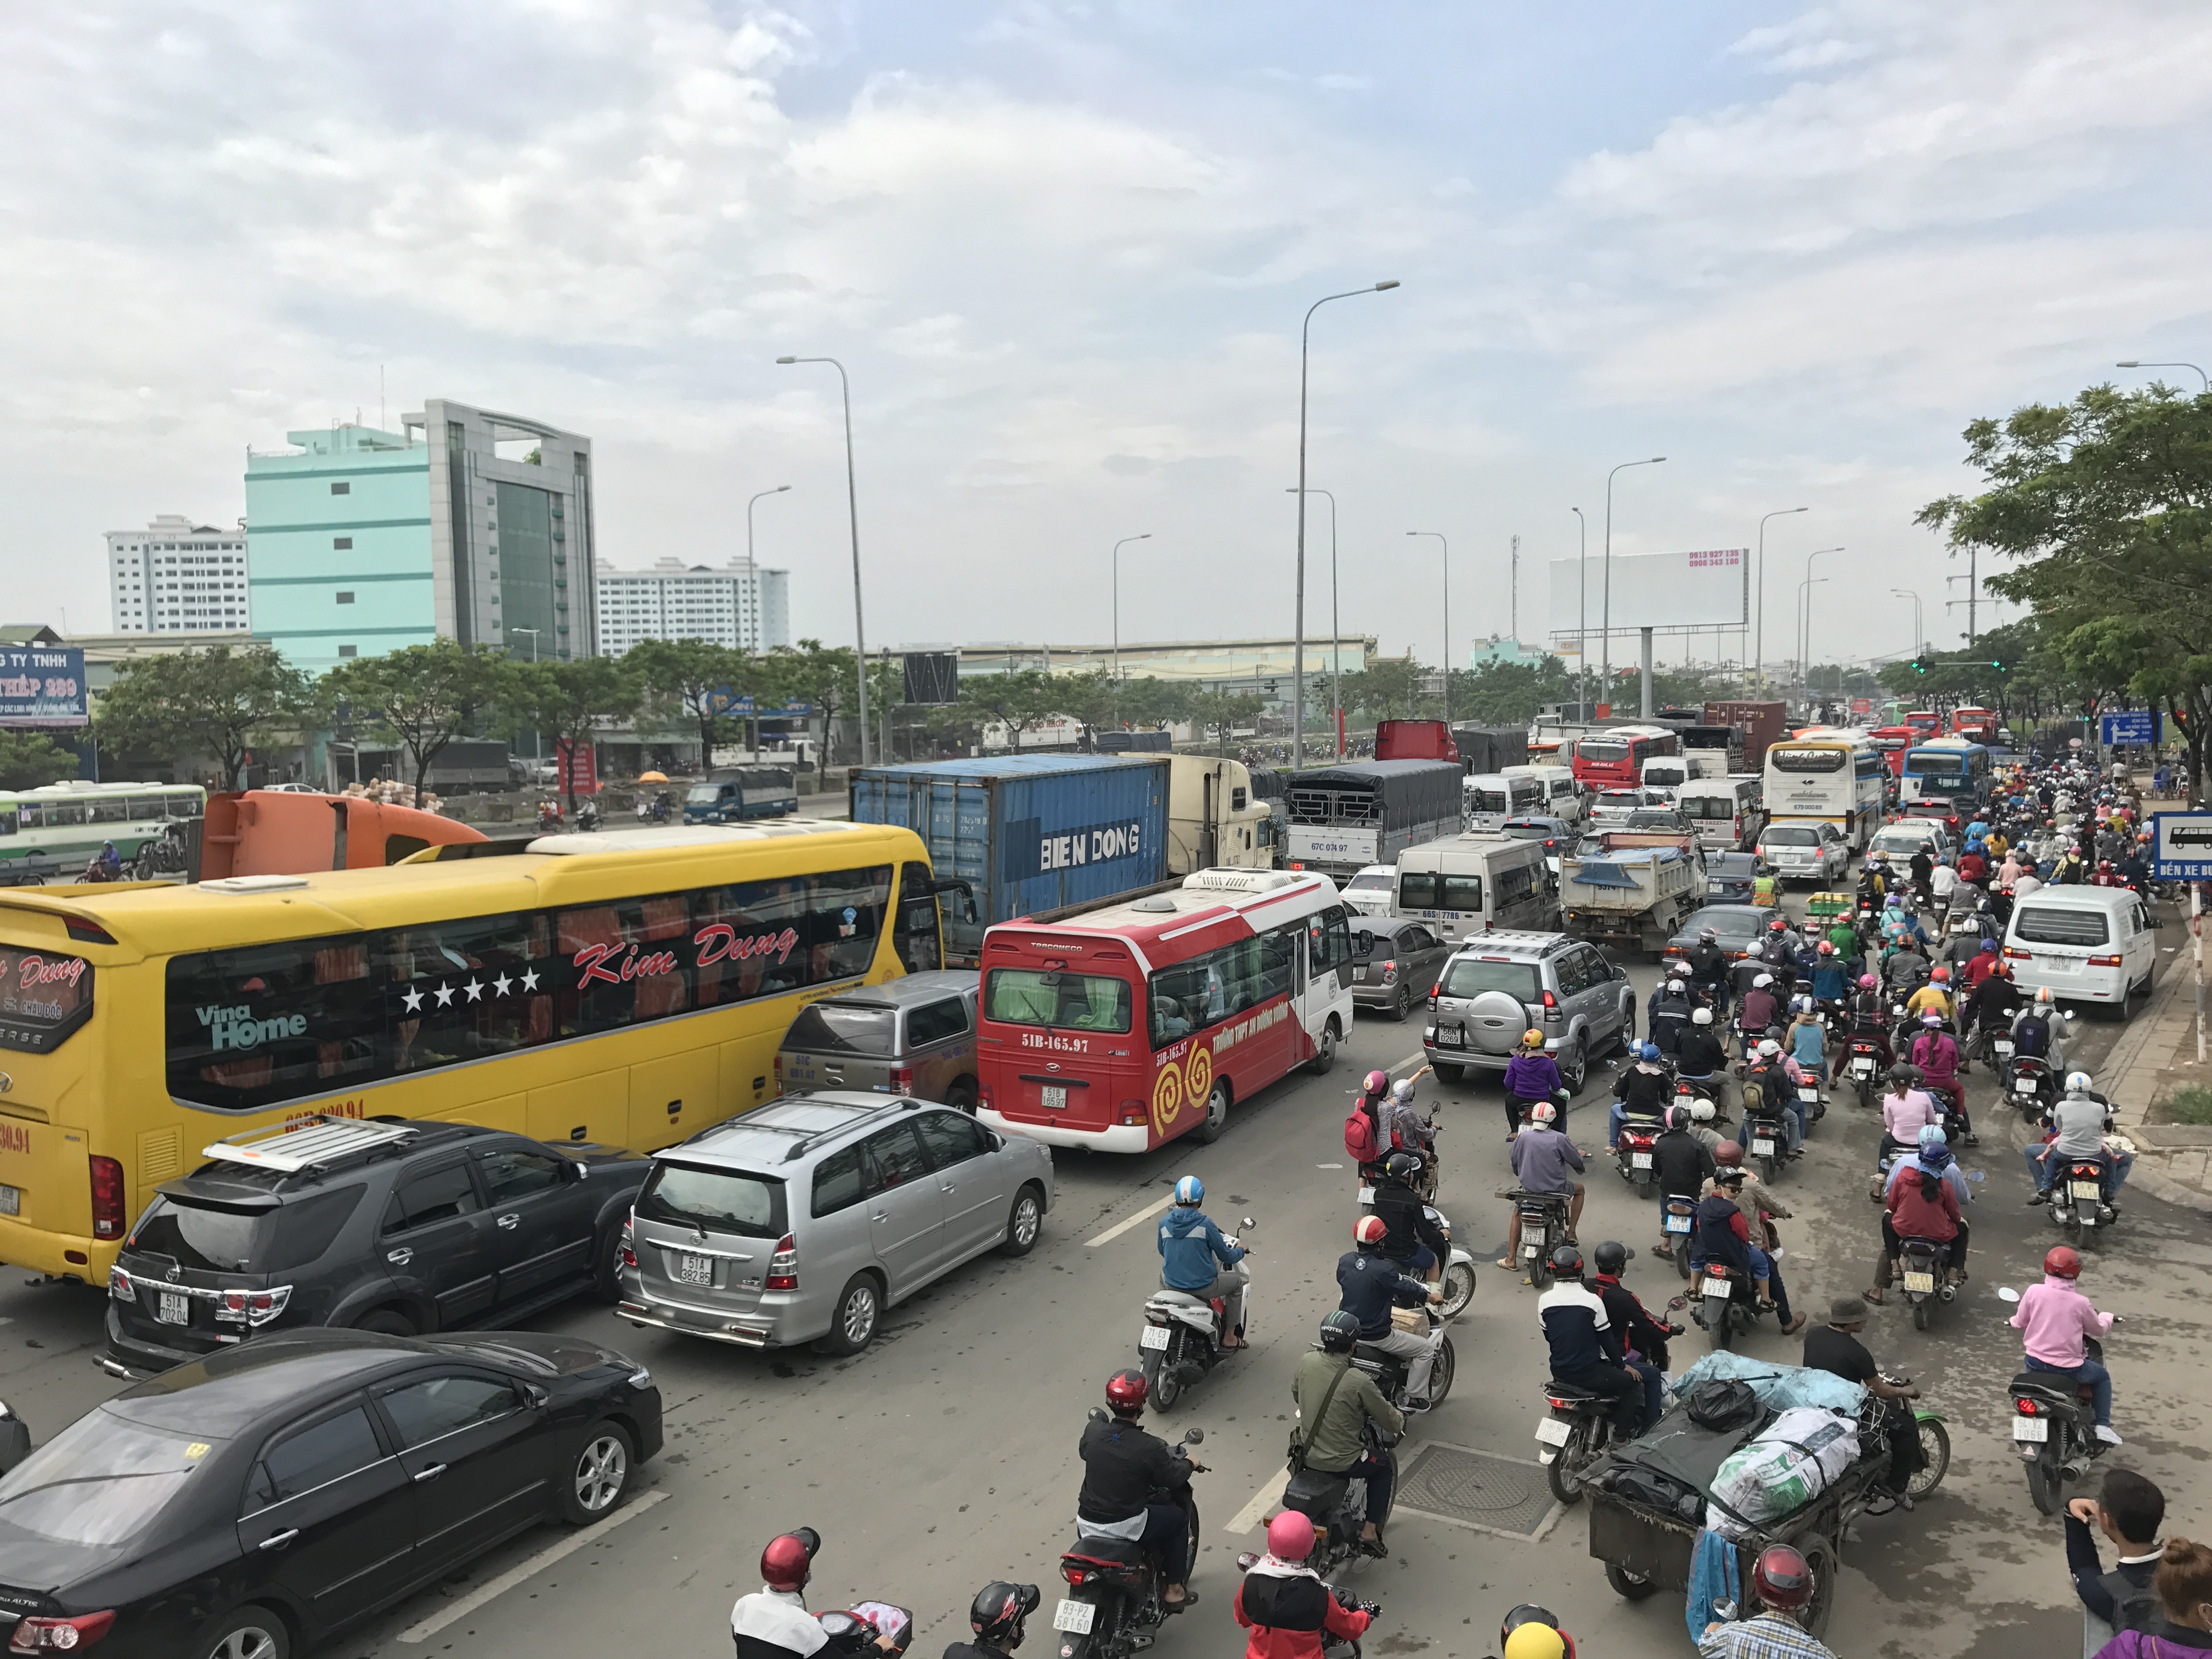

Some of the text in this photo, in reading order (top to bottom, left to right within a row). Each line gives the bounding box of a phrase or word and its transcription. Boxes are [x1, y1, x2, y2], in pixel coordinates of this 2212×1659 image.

[10, 653, 27, 667] TY
[32, 654, 67, 667] TNHH
[1041, 824, 1139, 871] BIEN DONG
[2185, 866, 2198, 876] XE
[1030, 942, 1082, 952] TRACOMECO
[573, 923, 799, 990] Kim Dung
[19, 955, 86, 990] Dung
[195, 1004, 251, 1028] Vina
[211, 1014, 308, 1051] Home
[1234, 1019, 1248, 1045] THPT
[1248, 1015, 1256, 1037] AN
[1022, 1033, 1089, 1053] 51B-165.97
[1440, 1035, 1459, 1043] 0269
[1156, 1041, 1188, 1068] 51B-165.97
[1047, 1088, 1060, 1097] 51B
[1525, 1235, 1542, 1244] 6172
[689, 1257, 704, 1271] 51A
[1707, 1286, 1726, 1296] 9315
[166, 1295, 182, 1310] 51A
[1148, 1328, 1167, 1339] 71-C3
[1143, 1337, 1167, 1349] 204.58
[2018, 1429, 2042, 1441] 1066
[1062, 1601, 1090, 1618] 83-P2
[1056, 1615, 1090, 1633] 581.60
